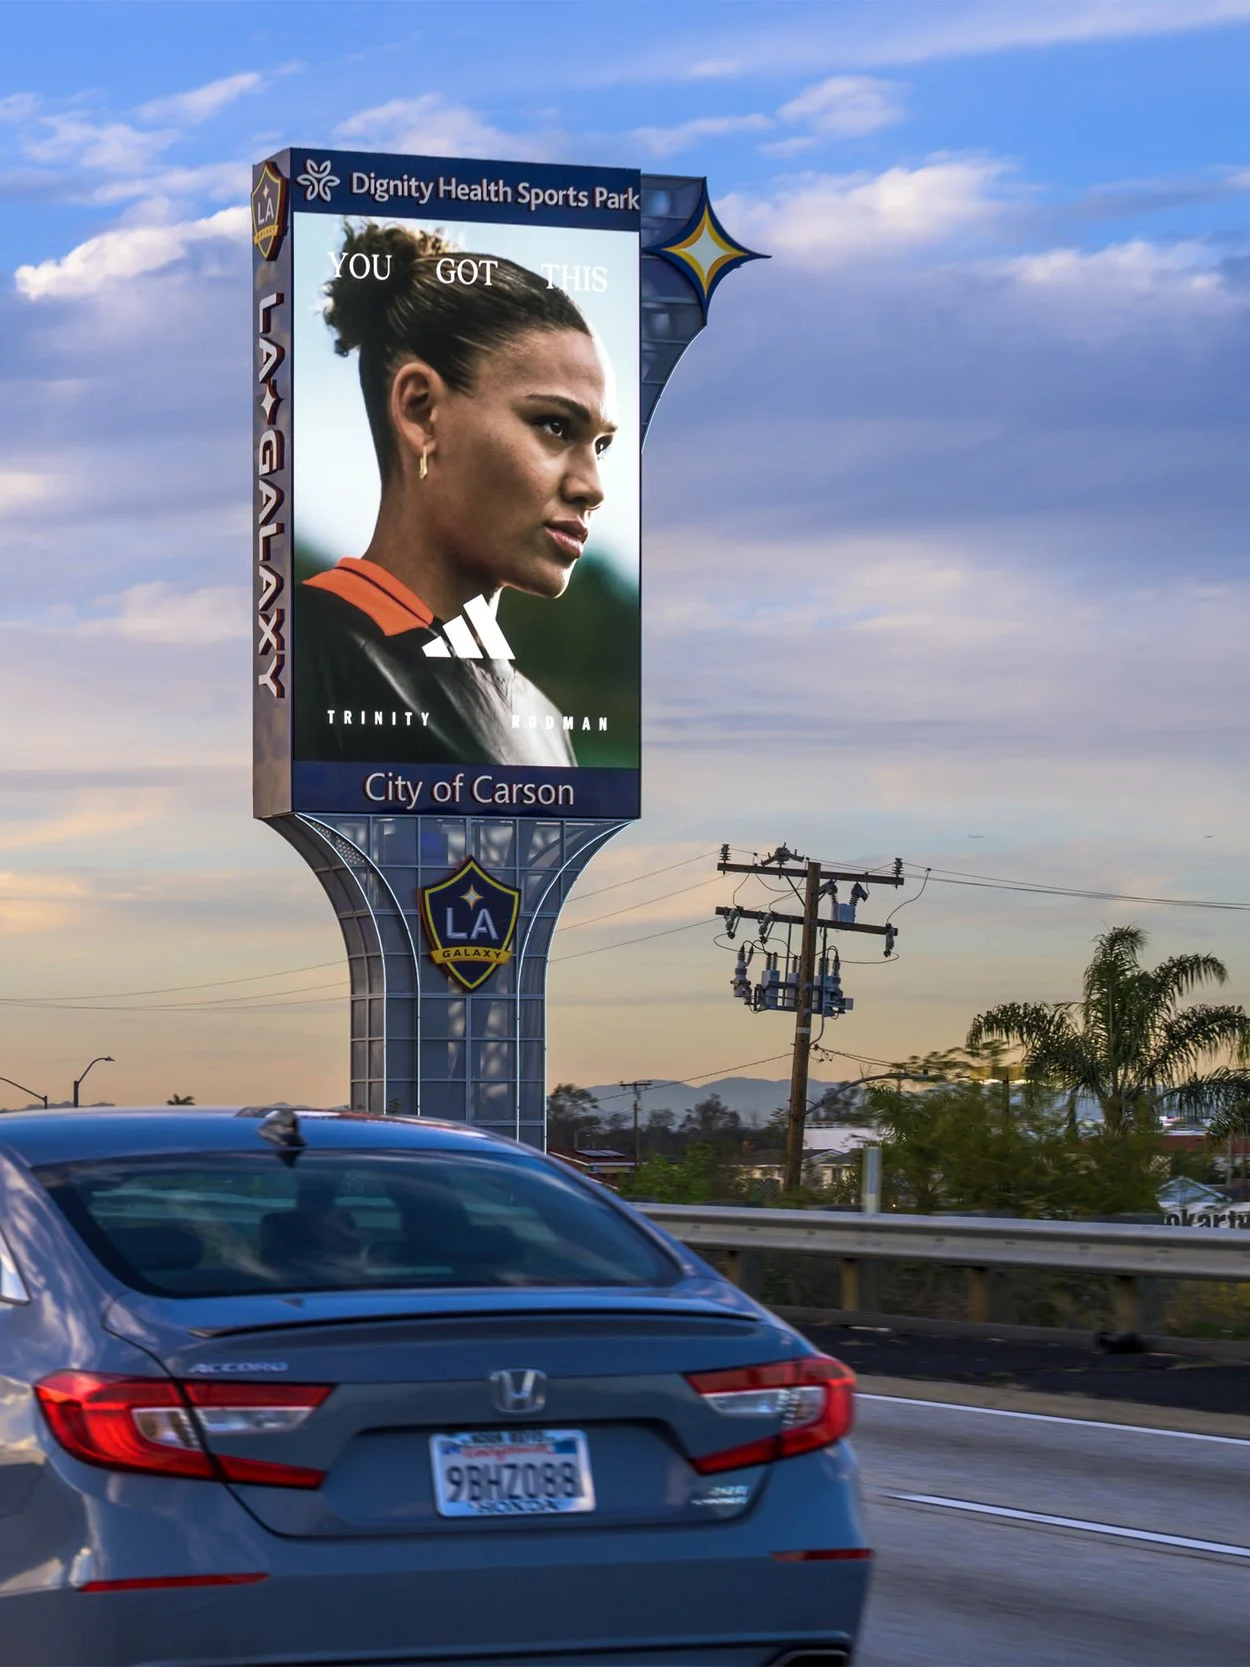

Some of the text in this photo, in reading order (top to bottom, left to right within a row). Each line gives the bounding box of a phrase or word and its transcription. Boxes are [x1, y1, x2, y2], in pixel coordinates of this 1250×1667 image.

[352, 172, 640, 211] Dignity Health Sports Park
[257, 198, 275, 225] LA
[327, 251, 608, 293] YOU GOT THIS
[259, 429, 283, 699] GALAXY
[327, 709, 608, 731] TRINITY RODMAN
[364, 771, 574, 809] City of Carson
[446, 907, 499, 940] LA
[442, 949, 501, 959] GALAXY
[187, 1363, 289, 1374] ACCORD
[445, 1461, 578, 1501] 9BHZ088
